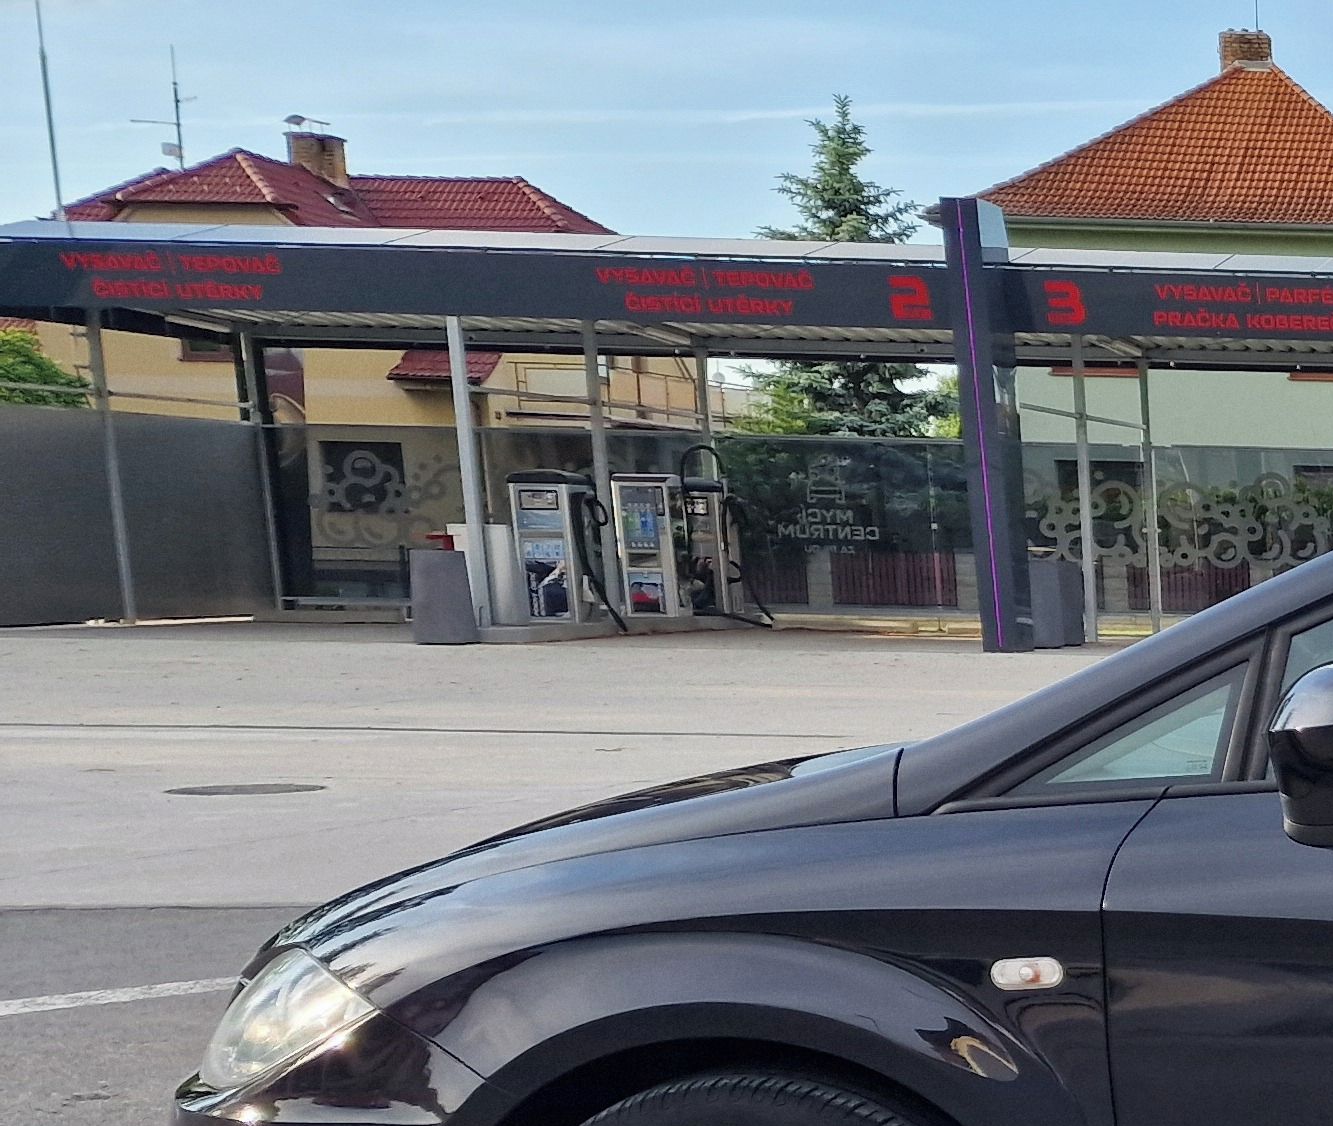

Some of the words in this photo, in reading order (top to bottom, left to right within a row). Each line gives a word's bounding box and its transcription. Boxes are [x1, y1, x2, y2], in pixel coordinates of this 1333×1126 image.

[59, 250, 162, 271] VYSAVAČ
[178, 253, 282, 275] TEPOVAČ
[175, 280, 264, 300] UTĚRKY
[595, 265, 696, 287] VYSAVAČ
[712, 269, 815, 290] TEPOVAČ
[624, 290, 702, 314] ČISTÍCÍ
[707, 293, 794, 316] UTĚRKY
[886, 275, 933, 321] 2
[1042, 279, 1087, 326] 3
[1154, 281, 1251, 303] VYSAVAČ
[1153, 308, 1240, 329] PRAČKA
